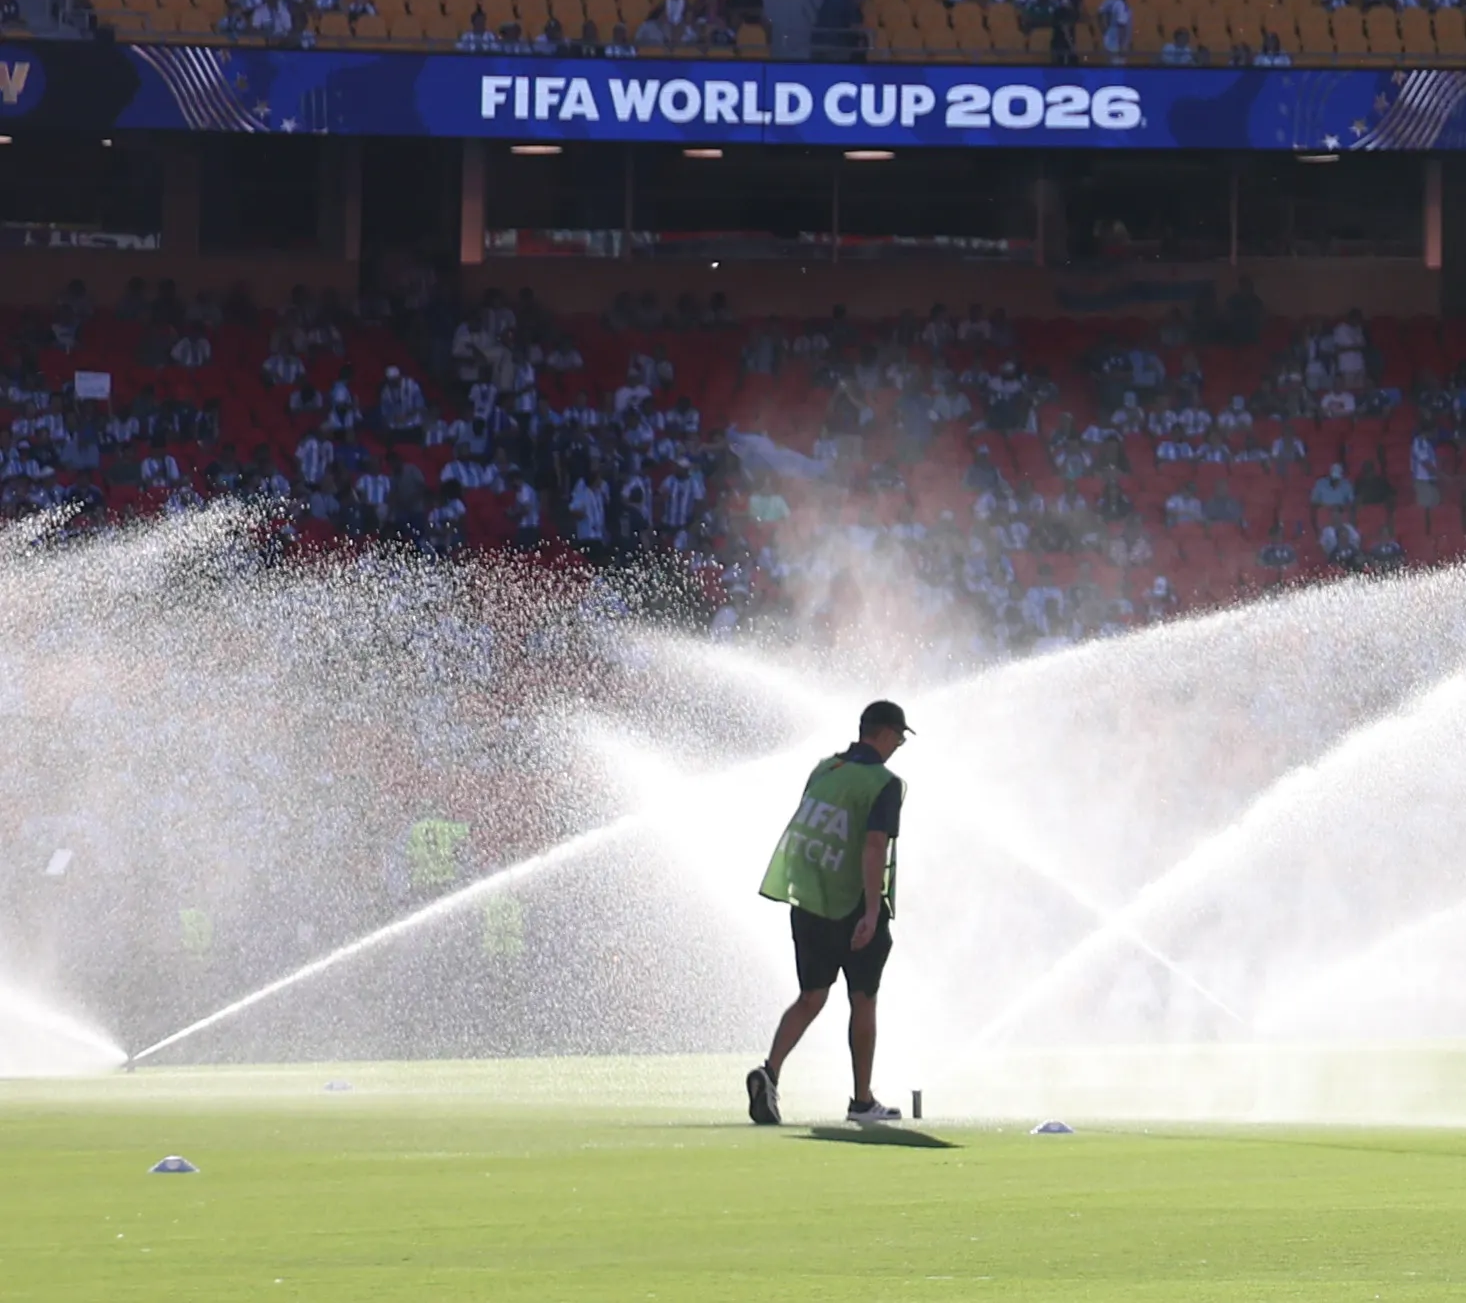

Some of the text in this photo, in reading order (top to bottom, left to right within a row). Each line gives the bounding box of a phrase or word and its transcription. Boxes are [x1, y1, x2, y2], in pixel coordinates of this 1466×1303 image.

[480, 75, 1141, 130] FIFA WORLD CUP 2026
[796, 794, 848, 842] IFA
[778, 830, 845, 872] ITCH
